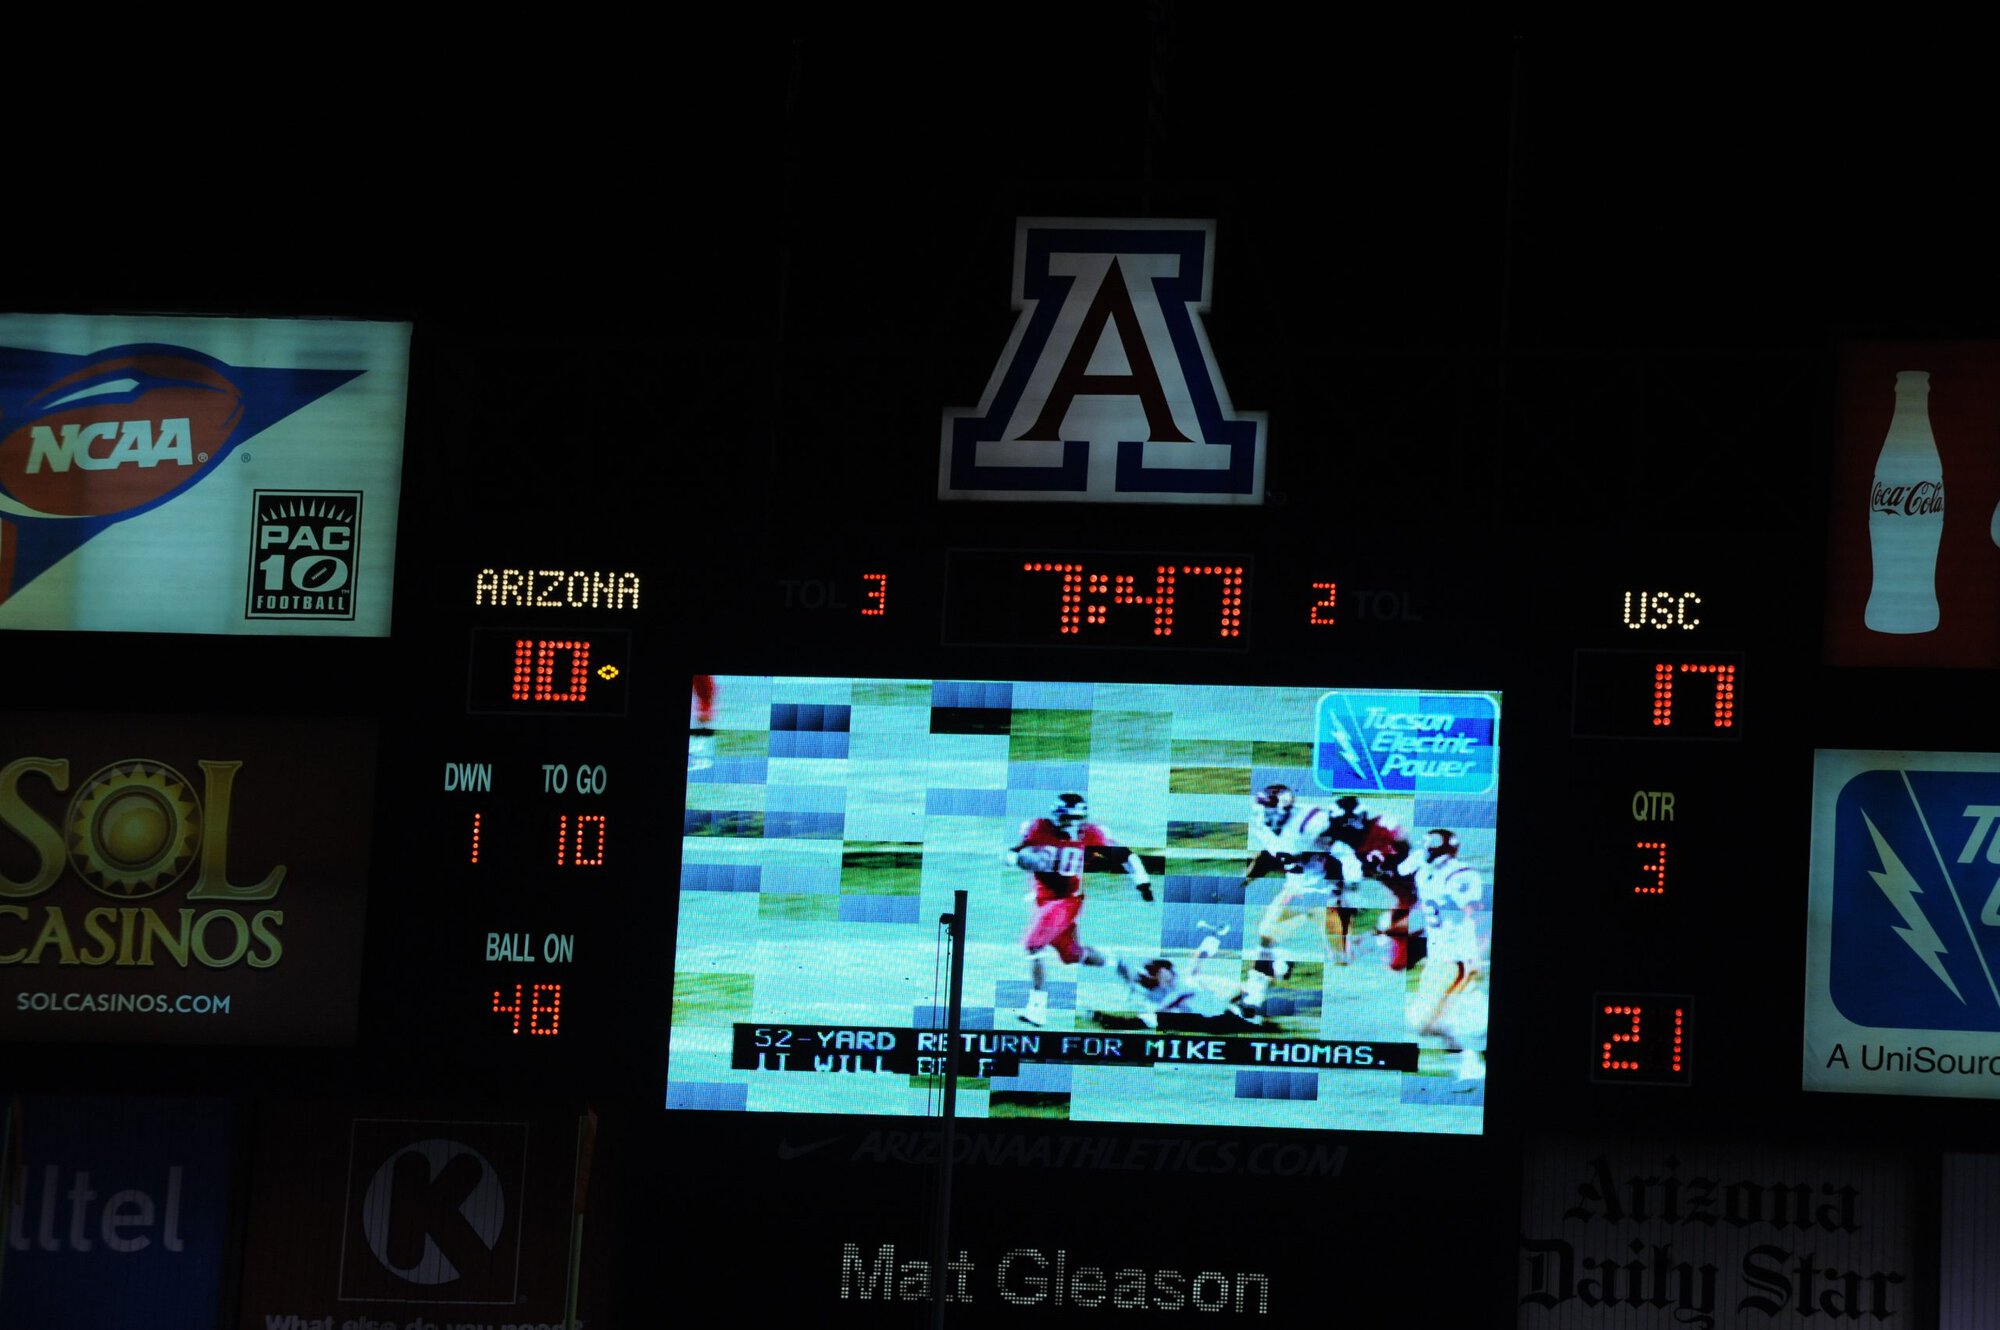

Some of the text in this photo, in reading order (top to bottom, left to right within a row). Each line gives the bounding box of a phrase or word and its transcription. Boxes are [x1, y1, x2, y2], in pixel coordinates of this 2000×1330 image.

[938, 216, 1270, 505] A
[26, 417, 193, 474] NCAA
[1872, 480, 1944, 516] Coca-Cola
[260, 525, 351, 551] PAC
[259, 554, 349, 592] 10
[474, 569, 641, 610] ARIZONA
[778, 578, 848, 609] TOL
[256, 595, 345, 611] FOOTBALL
[861, 574, 886, 616] 3
[1022, 561, 1244, 639] 7:47
[1309, 582, 1337, 626] 2
[1352, 589, 1422, 622] TOL
[1622, 590, 1702, 631] USC
[511, 639, 591, 703] 10
[1652, 662, 1736, 728] 17
[1363, 706, 1456, 731] Tucson
[1370, 730, 1478, 754] Electric
[444, 762, 492, 793] DWN
[542, 763, 608, 794] TO GO
[1379, 752, 1477, 778] Power
[1631, 790, 1676, 822] QTR
[0, 756, 288, 900] SOL
[471, 812, 483, 865] 1
[558, 814, 606, 867] 10
[1632, 841, 1668, 895] 3
[486, 933, 575, 963] BALL ON
[16, 992, 232, 1015] SOLCASINOS.COM
[493, 983, 562, 1036] 48
[755, 1029, 1386, 1065] 52-YARD RETURN FOR MIKE THOMAS.
[1601, 1005, 1684, 1072] 21
[1826, 1044, 1849, 1069] A
[814, 1055, 894, 1074] WILL
[850, 1131, 1348, 1178] ARIZONAATHLETICS.COM
[1562, 1154, 1863, 1235] Arizona
[995, 1248, 1270, 1316] Gleason
[1520, 1236, 1905, 1330] Daily Star
